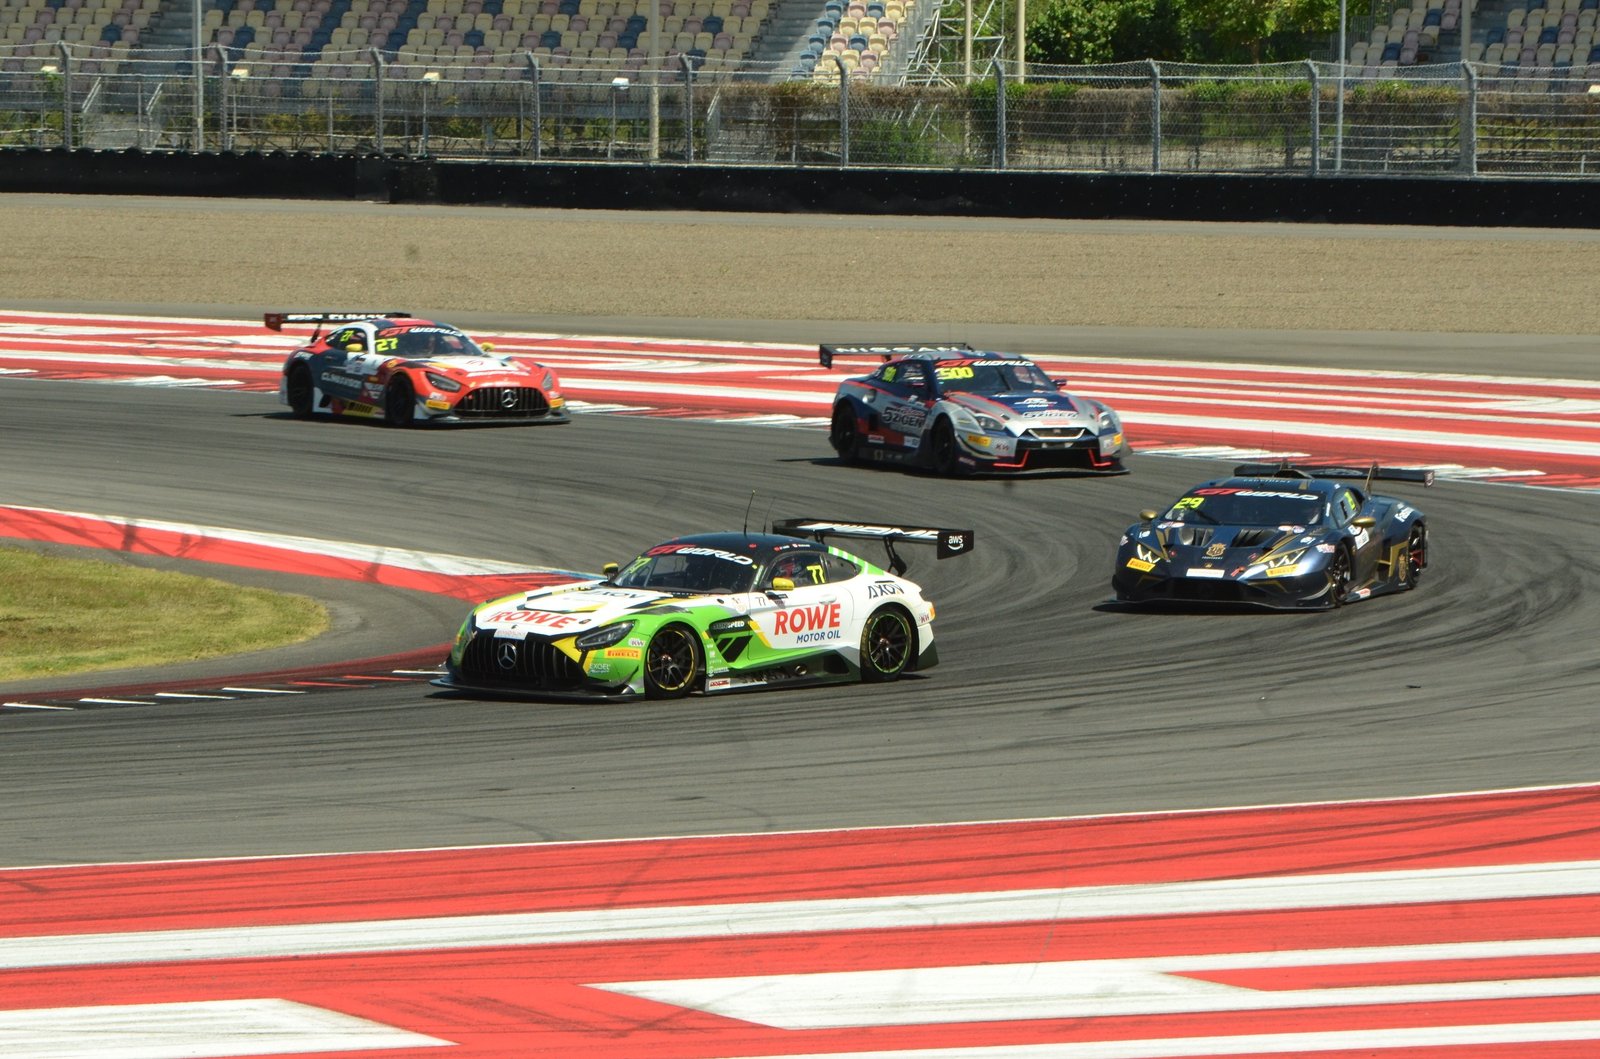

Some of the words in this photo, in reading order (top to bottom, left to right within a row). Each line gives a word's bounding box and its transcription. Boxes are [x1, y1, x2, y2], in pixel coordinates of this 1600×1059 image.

[340, 330, 354, 342] 27
[375, 337, 398, 352] 27
[933, 366, 974, 380] 500
[1173, 497, 1205, 510] 29
[948, 535, 963, 545] aws
[806, 564, 825, 584] 77
[487, 610, 577, 628] ROWE
[774, 603, 841, 635] ROWE
[796, 633, 825, 644] MOTOR
[827, 630, 841, 640] OIL
[607, 650, 639, 659] PIRELLI
